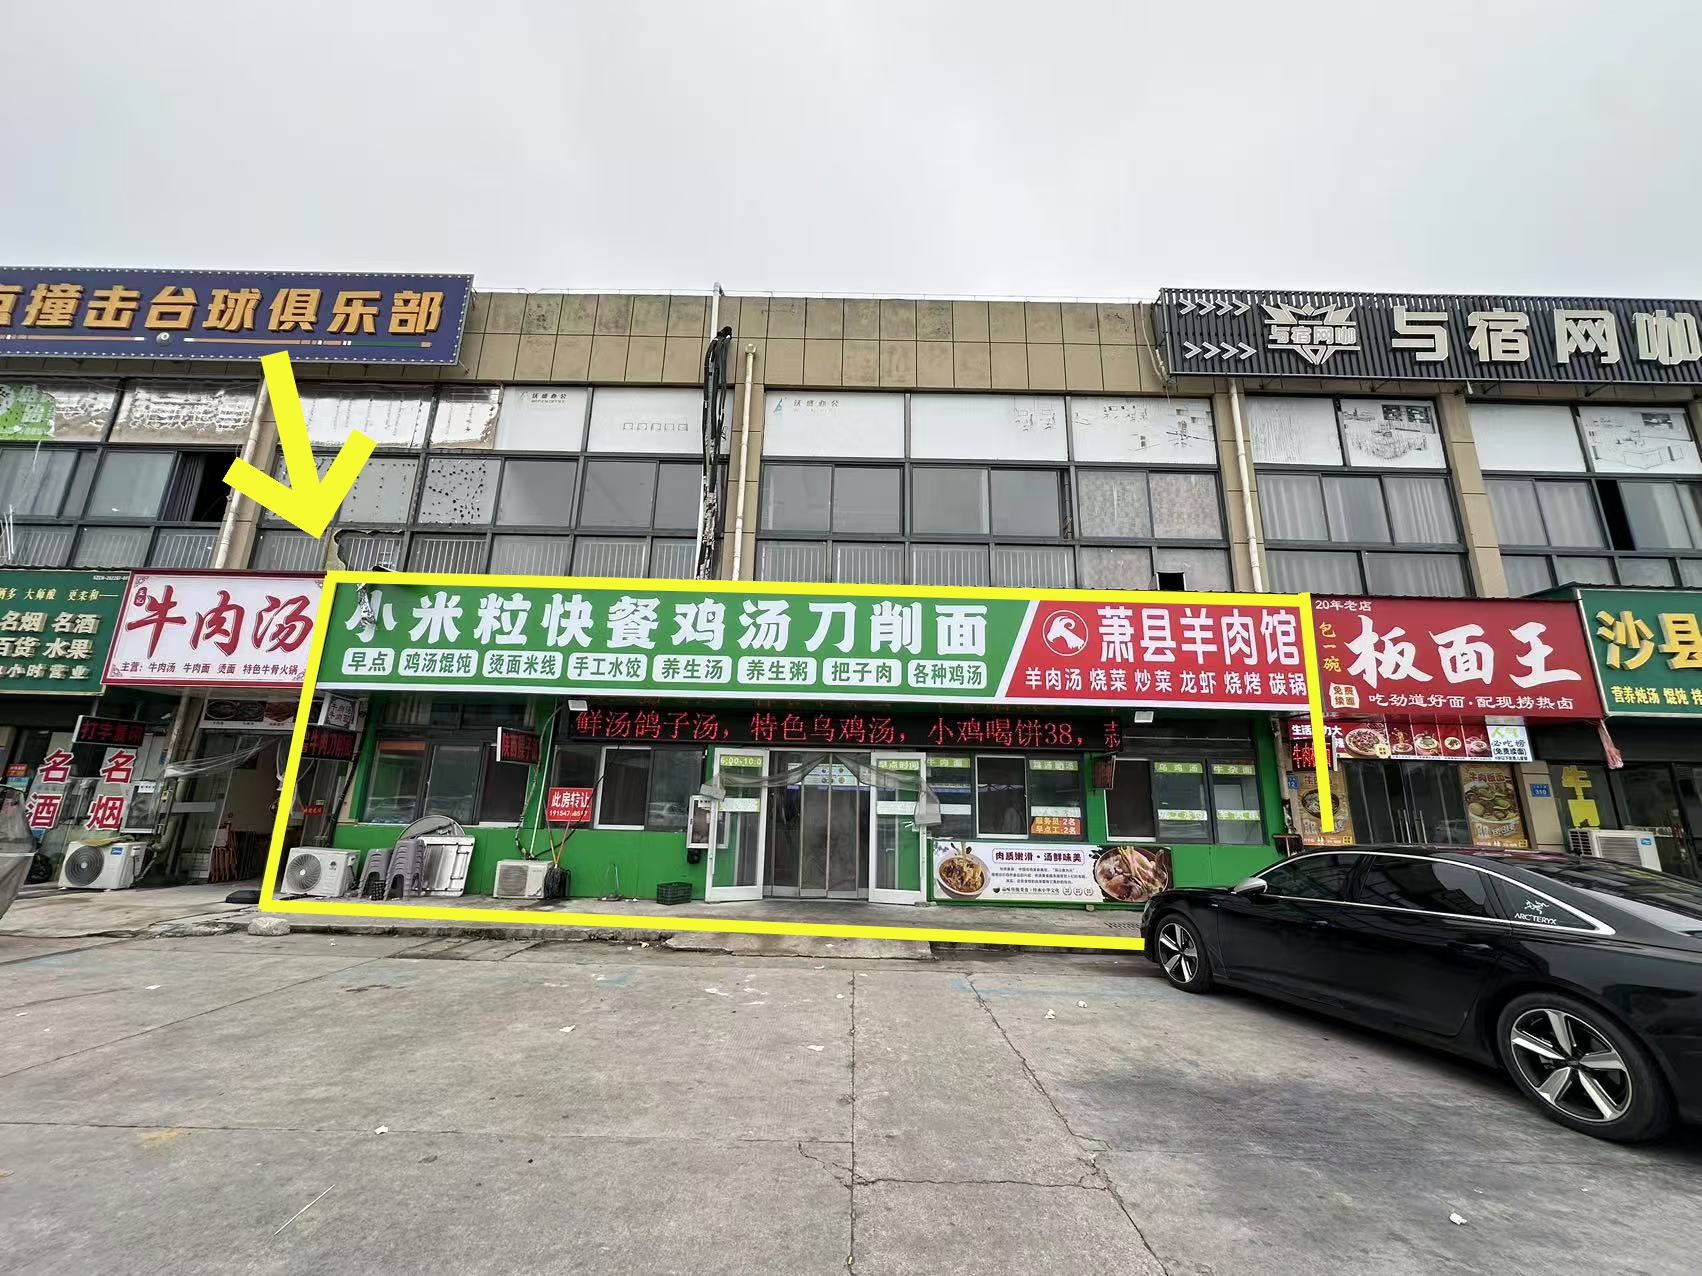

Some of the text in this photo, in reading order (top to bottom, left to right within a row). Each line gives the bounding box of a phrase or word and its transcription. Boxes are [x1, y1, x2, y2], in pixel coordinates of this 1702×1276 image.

[1269, 325, 1357, 345] 与宿网咖
[1392, 306, 1702, 366] 与宿网咖
[1315, 600, 1372, 612] 20年老店
[51, 611, 101, 634] 名酒
[125, 584, 315, 660] 牛肉汤
[345, 590, 988, 656] 小米粒快餐鸡汤刀削面
[1097, 606, 1300, 665] 萧县羊肉馆
[42, 637, 93, 660] 水果
[1344, 615, 1582, 689] 板面王
[1596, 610, 1702, 670] 沙县
[149, 662, 176, 673] 牛肉汤
[183, 663, 210, 674] 牛肉面
[217, 663, 236, 674] 烫面
[243, 664, 298, 676] 特色牛骨火锅
[348, 651, 983, 685] 早点 鸡汤馄饨 烫面米线 手工水饺 养生汤 养生粥 把子肉 各种鸡汤
[1025, 667, 1307, 696] 羊肉汤 烧菜 炒菜 龙虾 烧烤 碳锅
[1611, 685, 1660, 704] 营养炖汤
[1291, 724, 1343, 737] 生活力大
[26, 747, 74, 829] 名酒
[86, 747, 137, 831] 名烟
[551, 791, 590, 808] 此房转让
